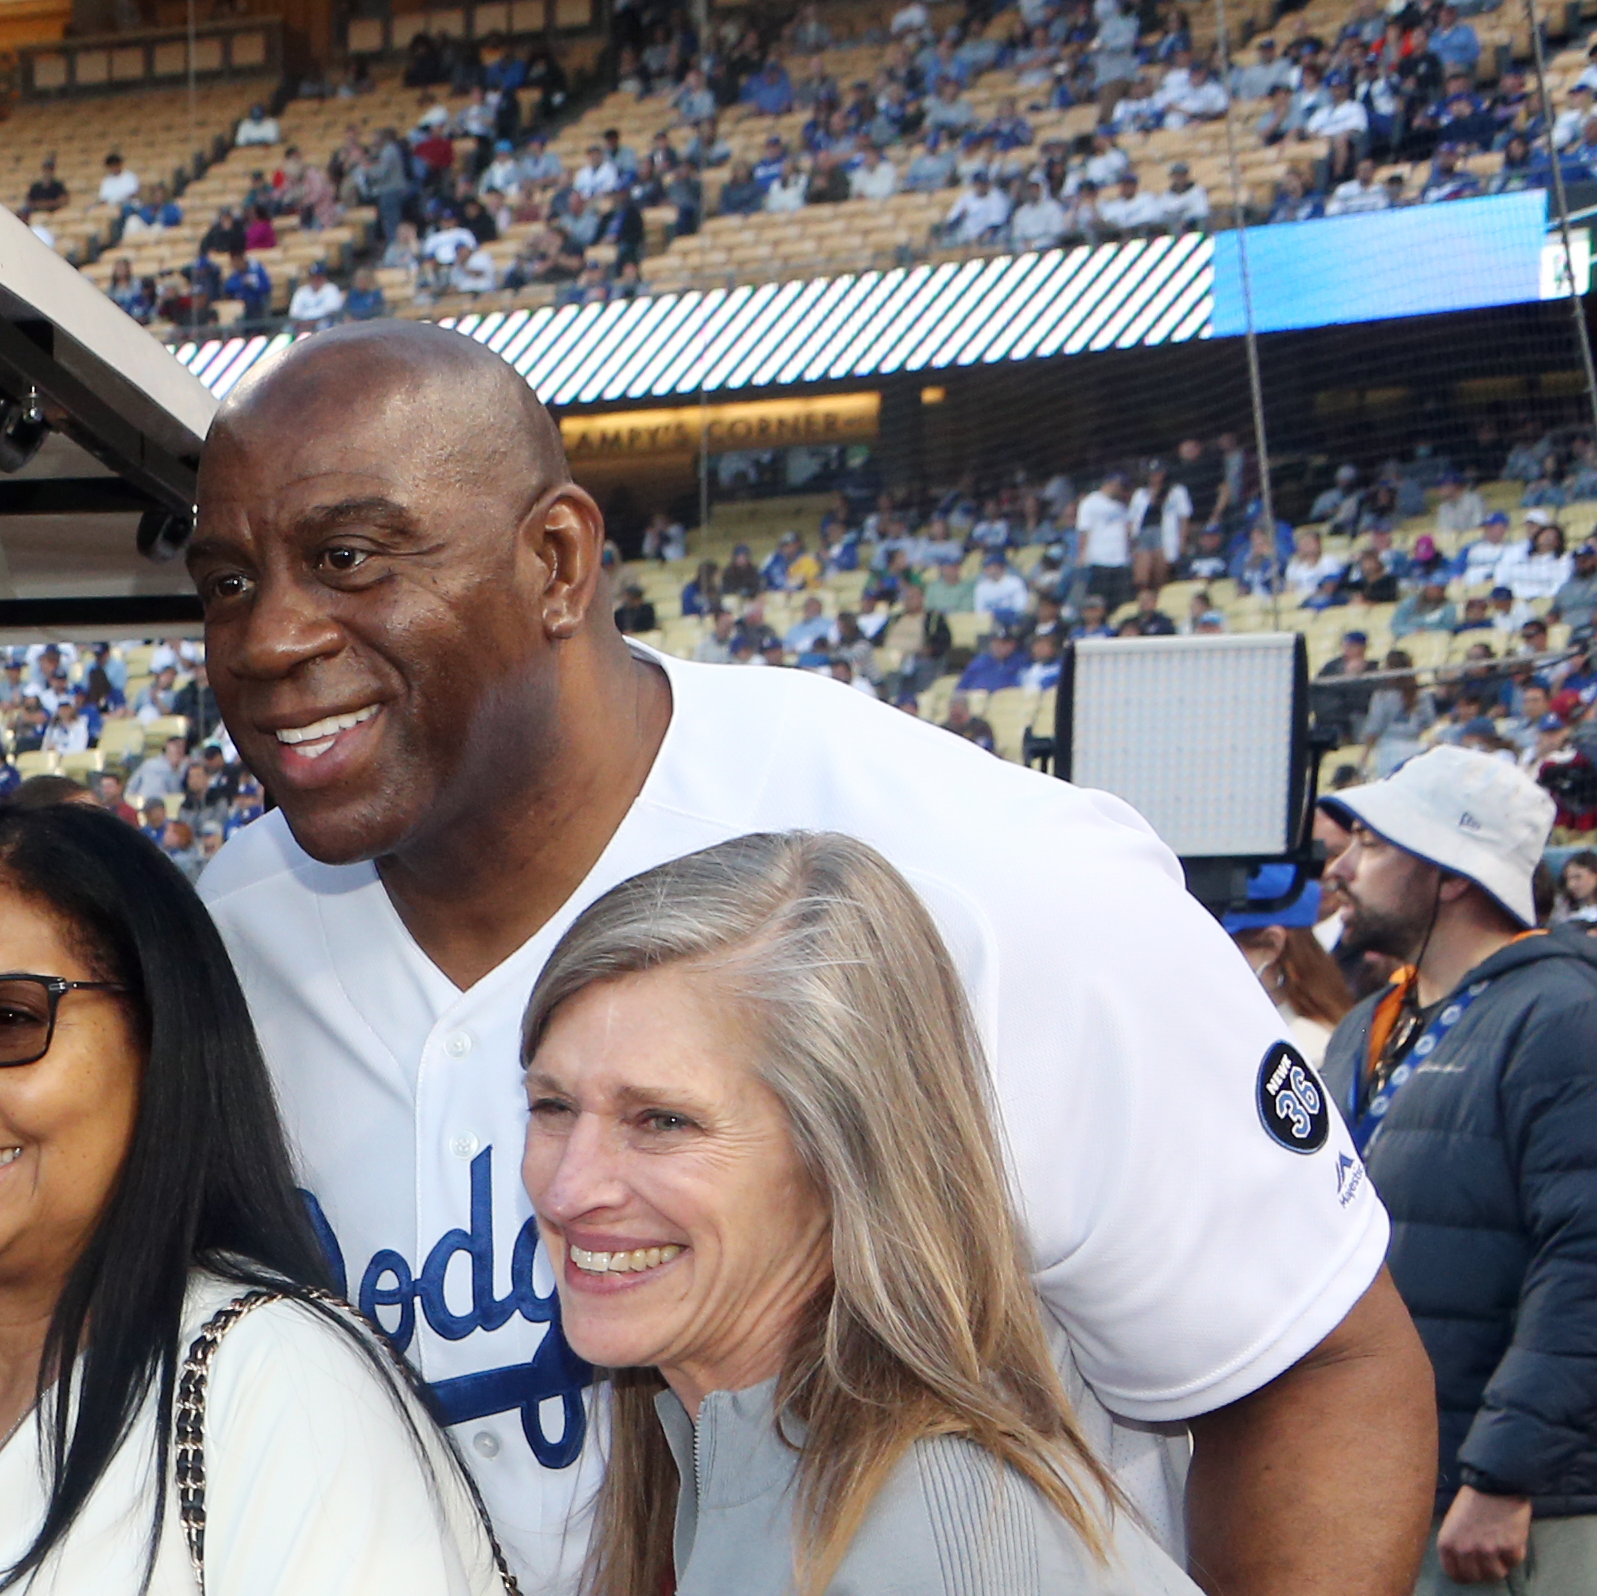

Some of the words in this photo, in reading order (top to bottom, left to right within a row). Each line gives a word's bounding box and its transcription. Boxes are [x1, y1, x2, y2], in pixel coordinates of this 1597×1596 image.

[574, 421, 691, 452] AMPY'S
[707, 411, 839, 441] CORNER
[1275, 1065, 1321, 1138] 36
